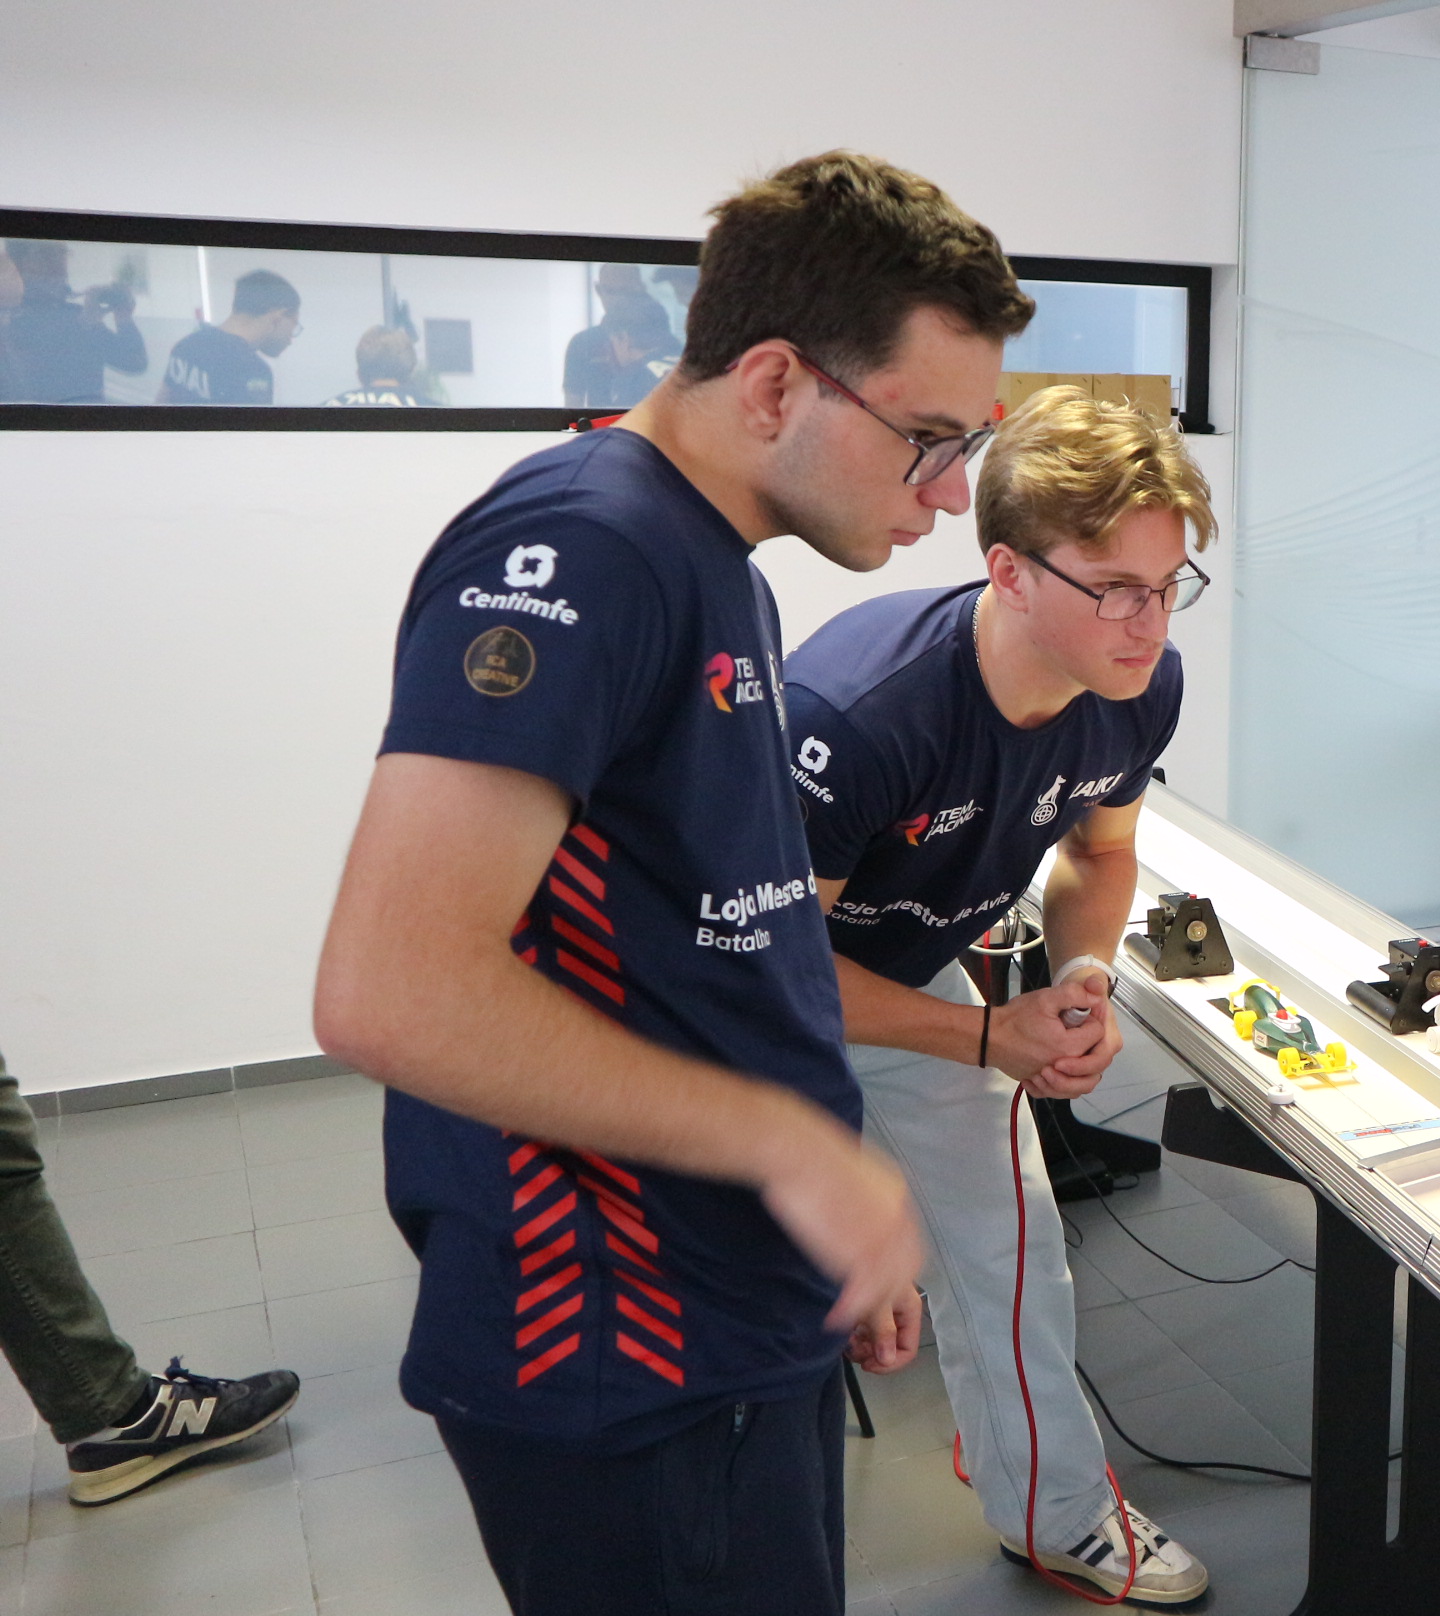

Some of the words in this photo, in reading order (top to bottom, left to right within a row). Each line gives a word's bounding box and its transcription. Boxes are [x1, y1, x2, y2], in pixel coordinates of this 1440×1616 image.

[459, 587, 578, 624] Centimfe
[790, 764, 834, 804] ntimfe
[700, 888, 755, 926] Loja
[807, 868, 817, 895] d
[696, 927, 771, 952] Batalha
